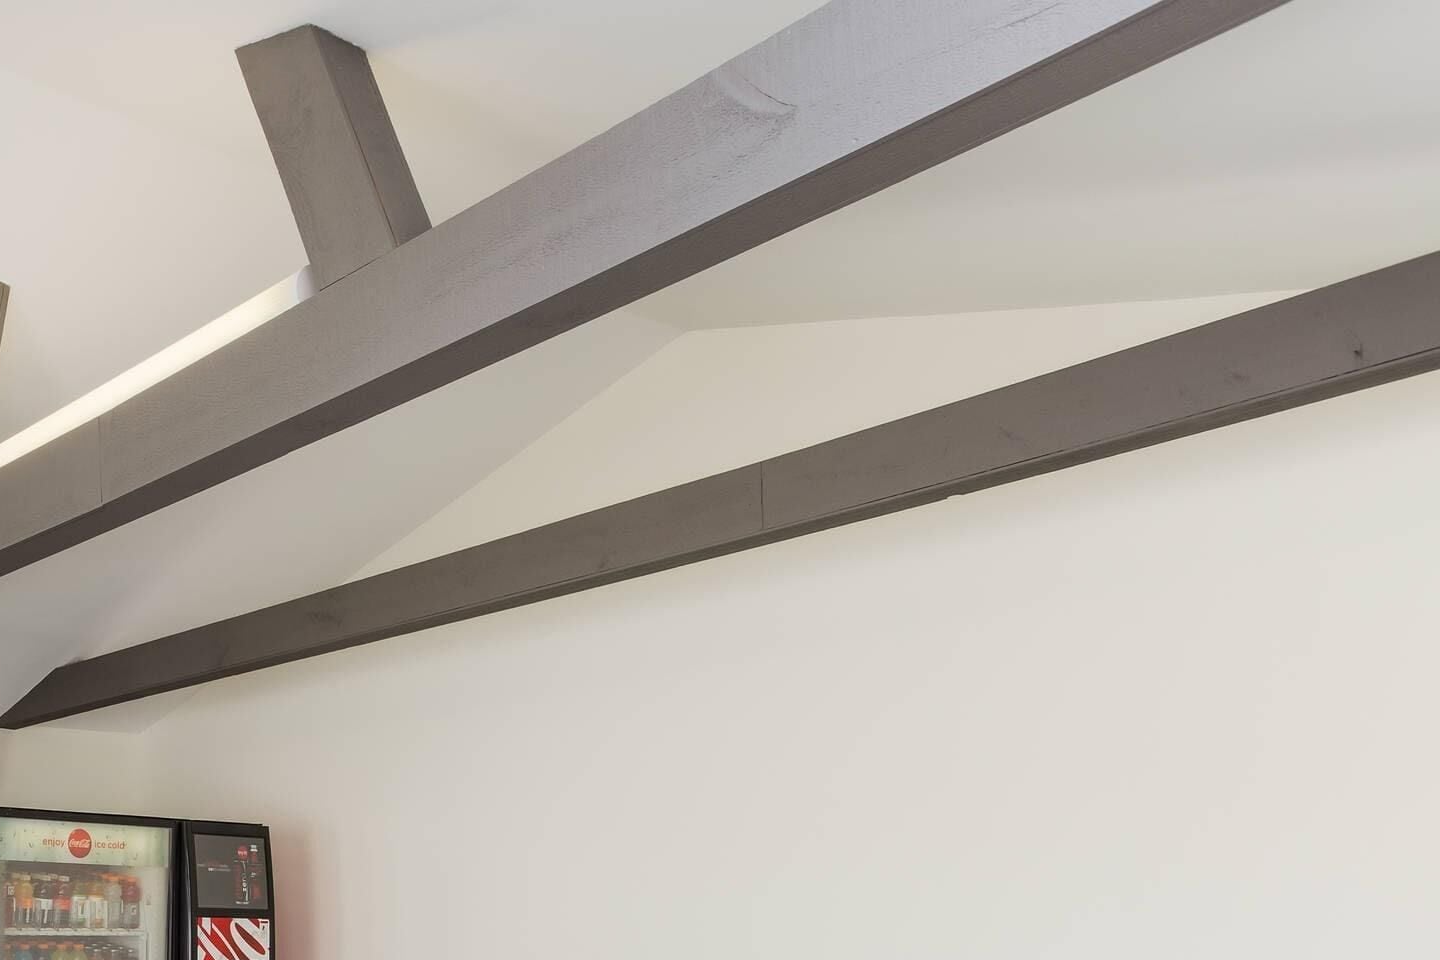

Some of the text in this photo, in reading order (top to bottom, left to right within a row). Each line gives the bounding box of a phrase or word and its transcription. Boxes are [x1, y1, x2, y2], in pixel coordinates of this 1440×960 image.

[42, 838, 65, 847] enjoy
[94, 840, 105, 848] ice
[107, 841, 125, 849] cold
